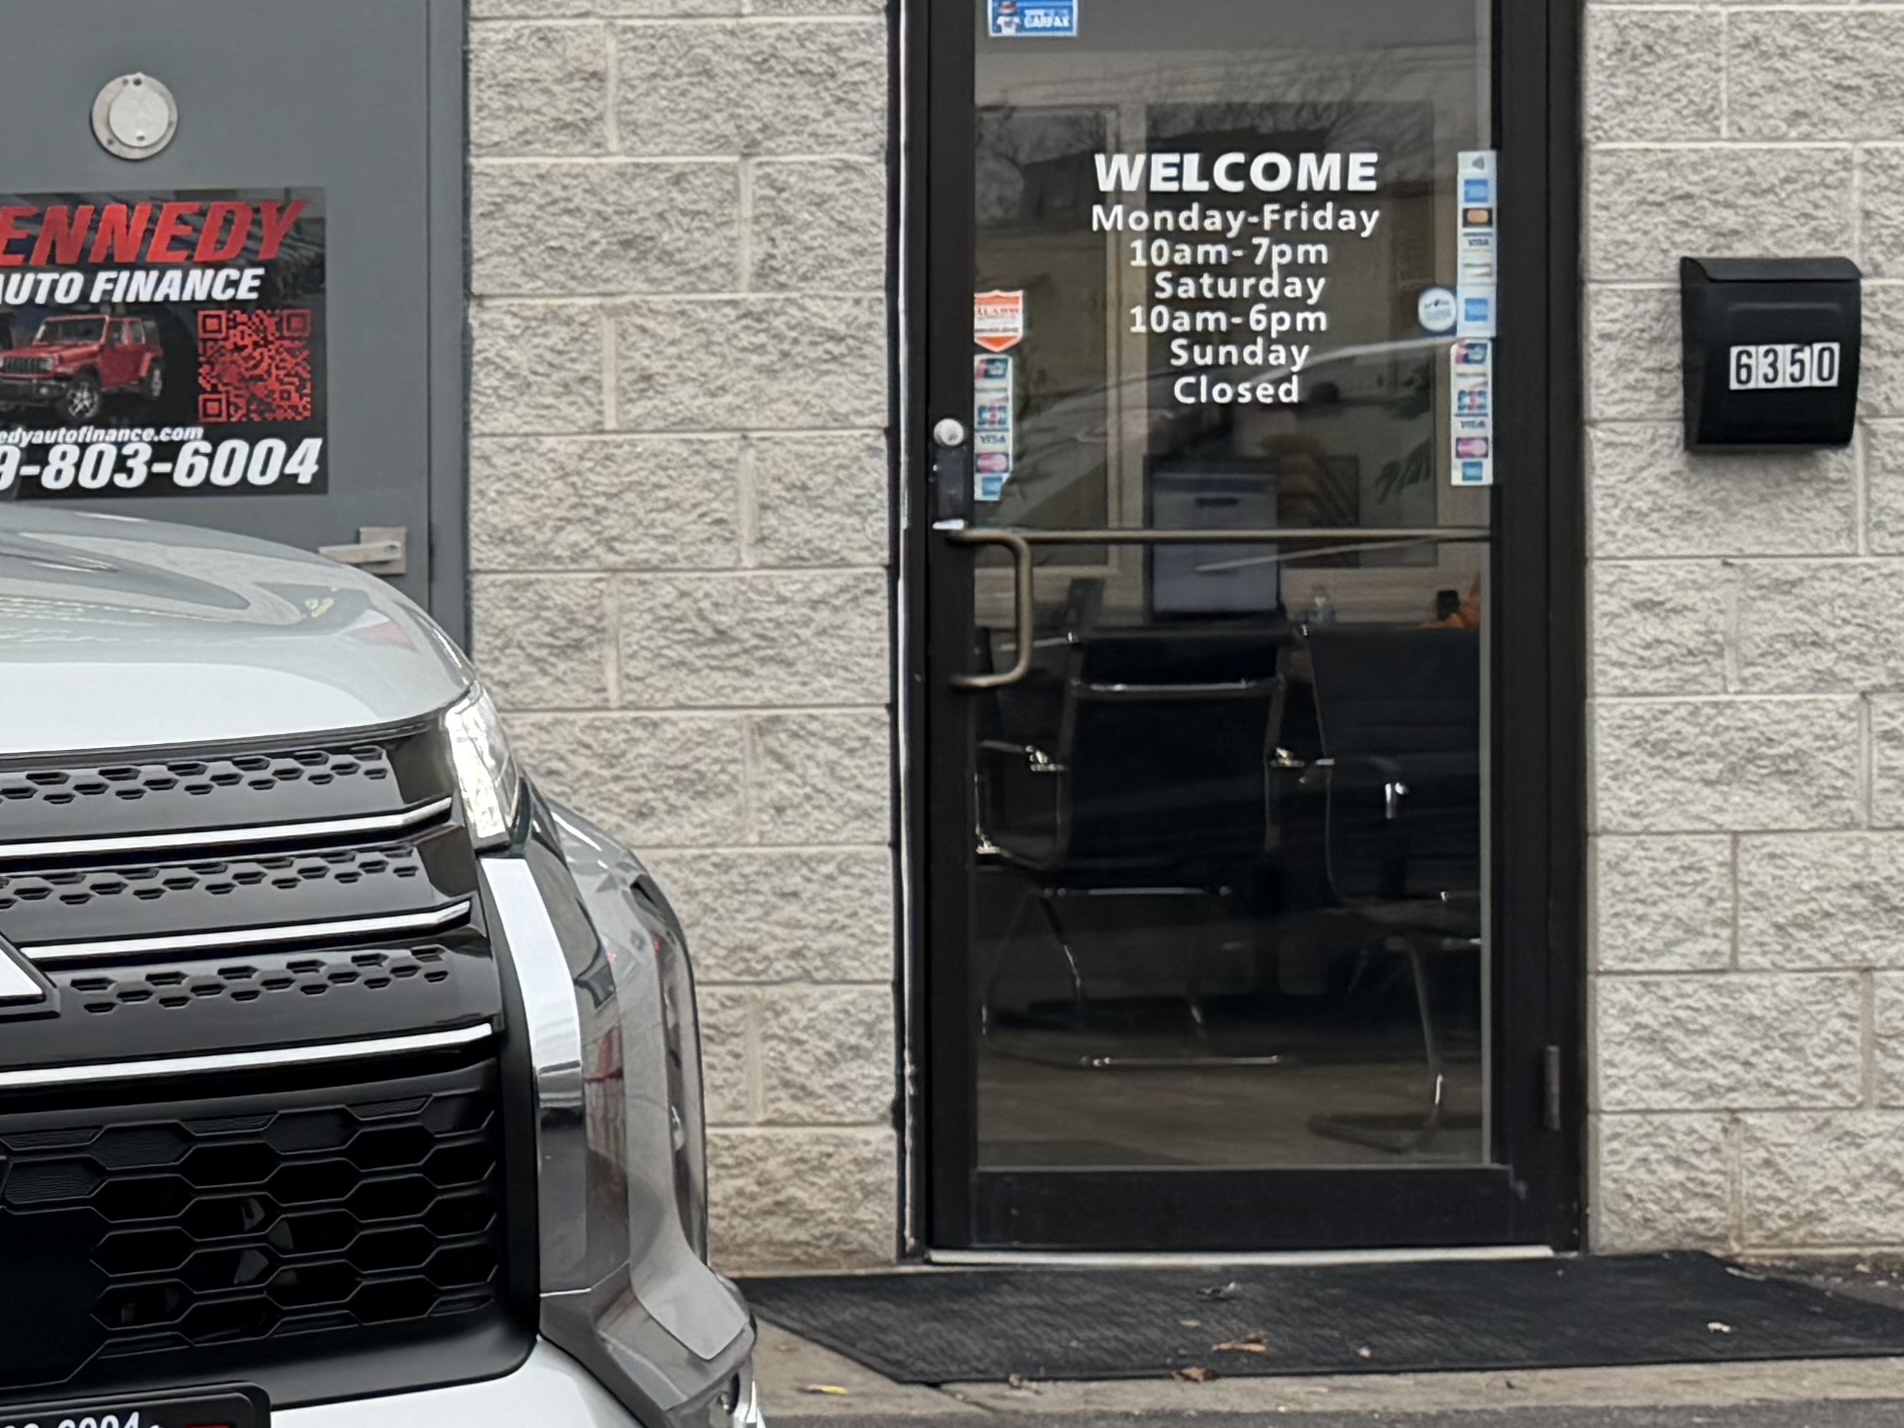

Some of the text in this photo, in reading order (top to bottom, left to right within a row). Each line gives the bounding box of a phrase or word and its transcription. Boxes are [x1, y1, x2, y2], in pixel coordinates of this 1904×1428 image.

[1094, 152, 1379, 192] WELCOME
[1091, 203, 1380, 238] Monday-Friday
[88, 267, 266, 304] FINANCE
[1154, 270, 1326, 305] Saturday
[1170, 337, 1311, 372] Sunday
[1735, 345, 1836, 385] 6350
[1173, 375, 1300, 405] Closed
